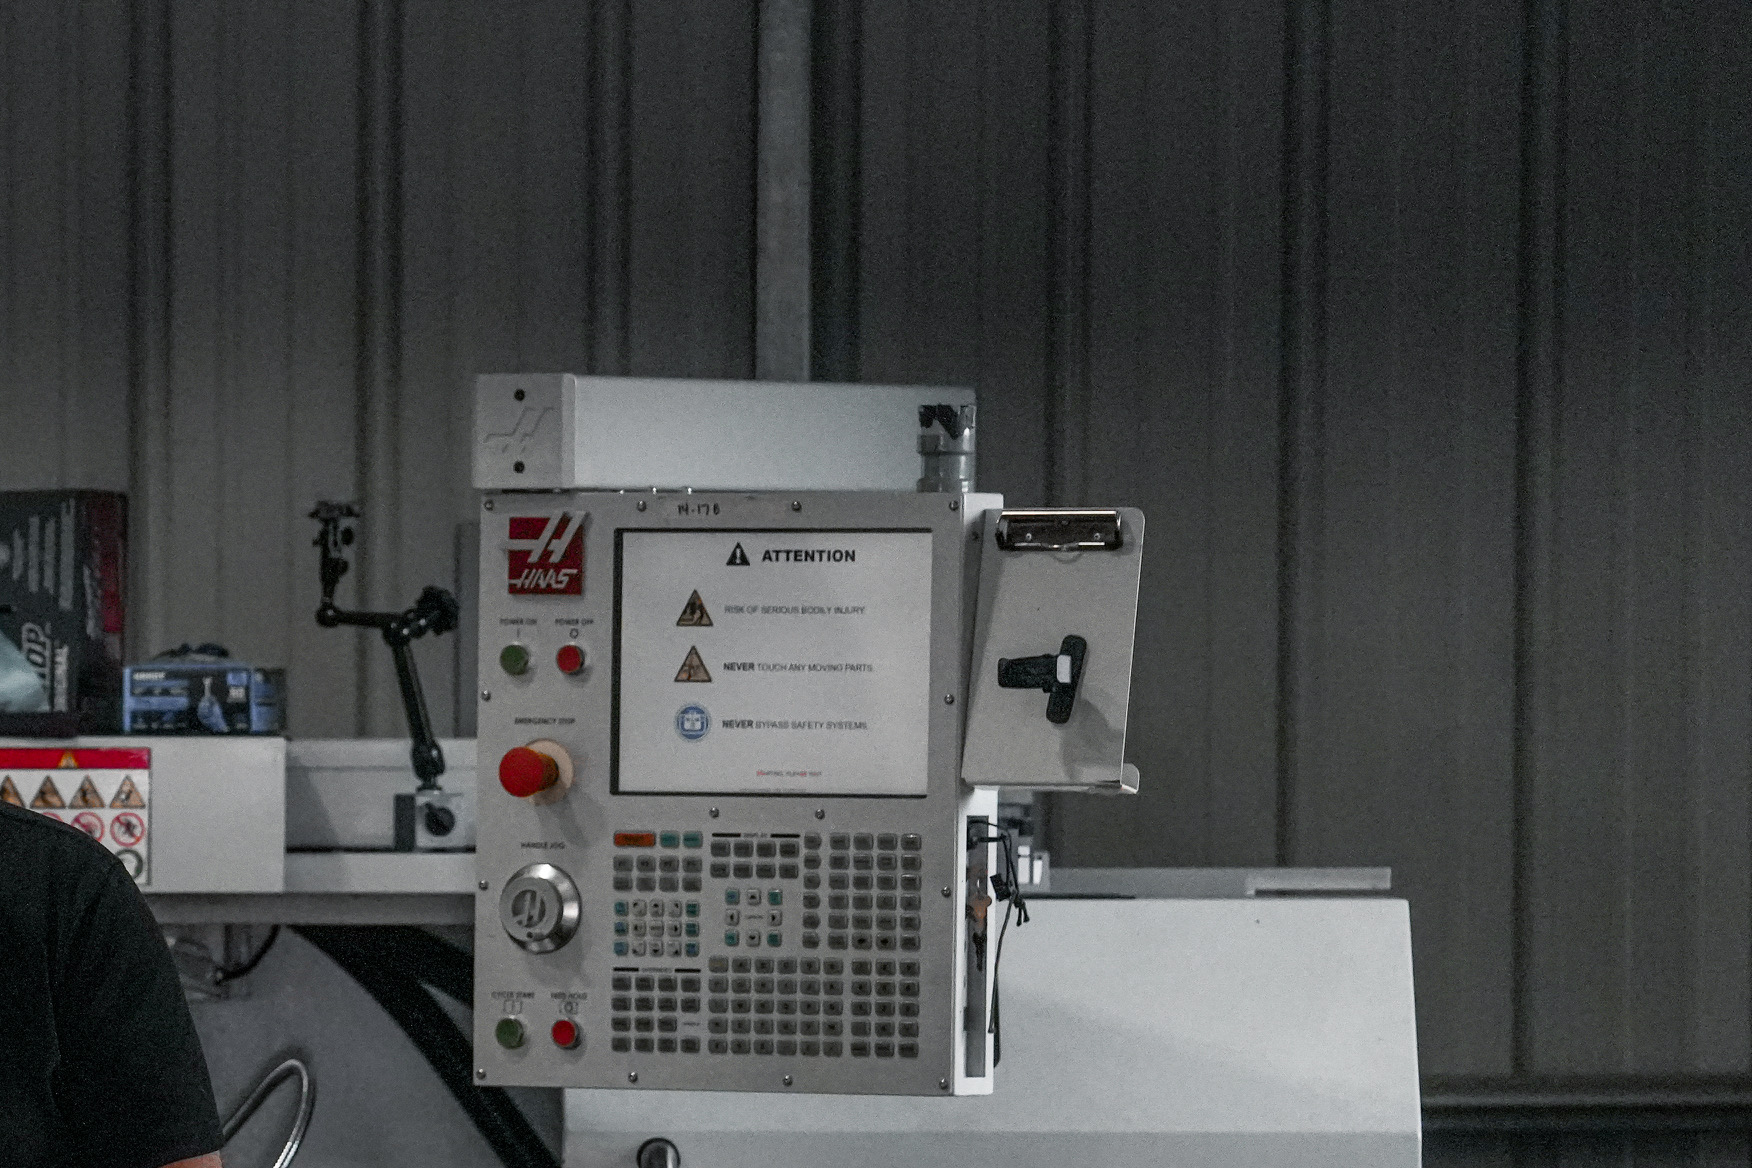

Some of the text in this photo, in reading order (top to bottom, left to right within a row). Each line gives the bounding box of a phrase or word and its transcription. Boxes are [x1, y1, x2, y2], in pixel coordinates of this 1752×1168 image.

[762, 549, 856, 563] ATTENTION
[509, 567, 579, 590] HAAS
[761, 605, 799, 615] SERIOUS
[723, 662, 755, 672] NEVER
[757, 663, 787, 673] TOUCH
[788, 663, 807, 673] ANY
[808, 663, 844, 673] MOVING
[722, 719, 754, 729] NEVER
[755, 720, 789, 730] BYPASS
[791, 720, 825, 730] SAFETY
